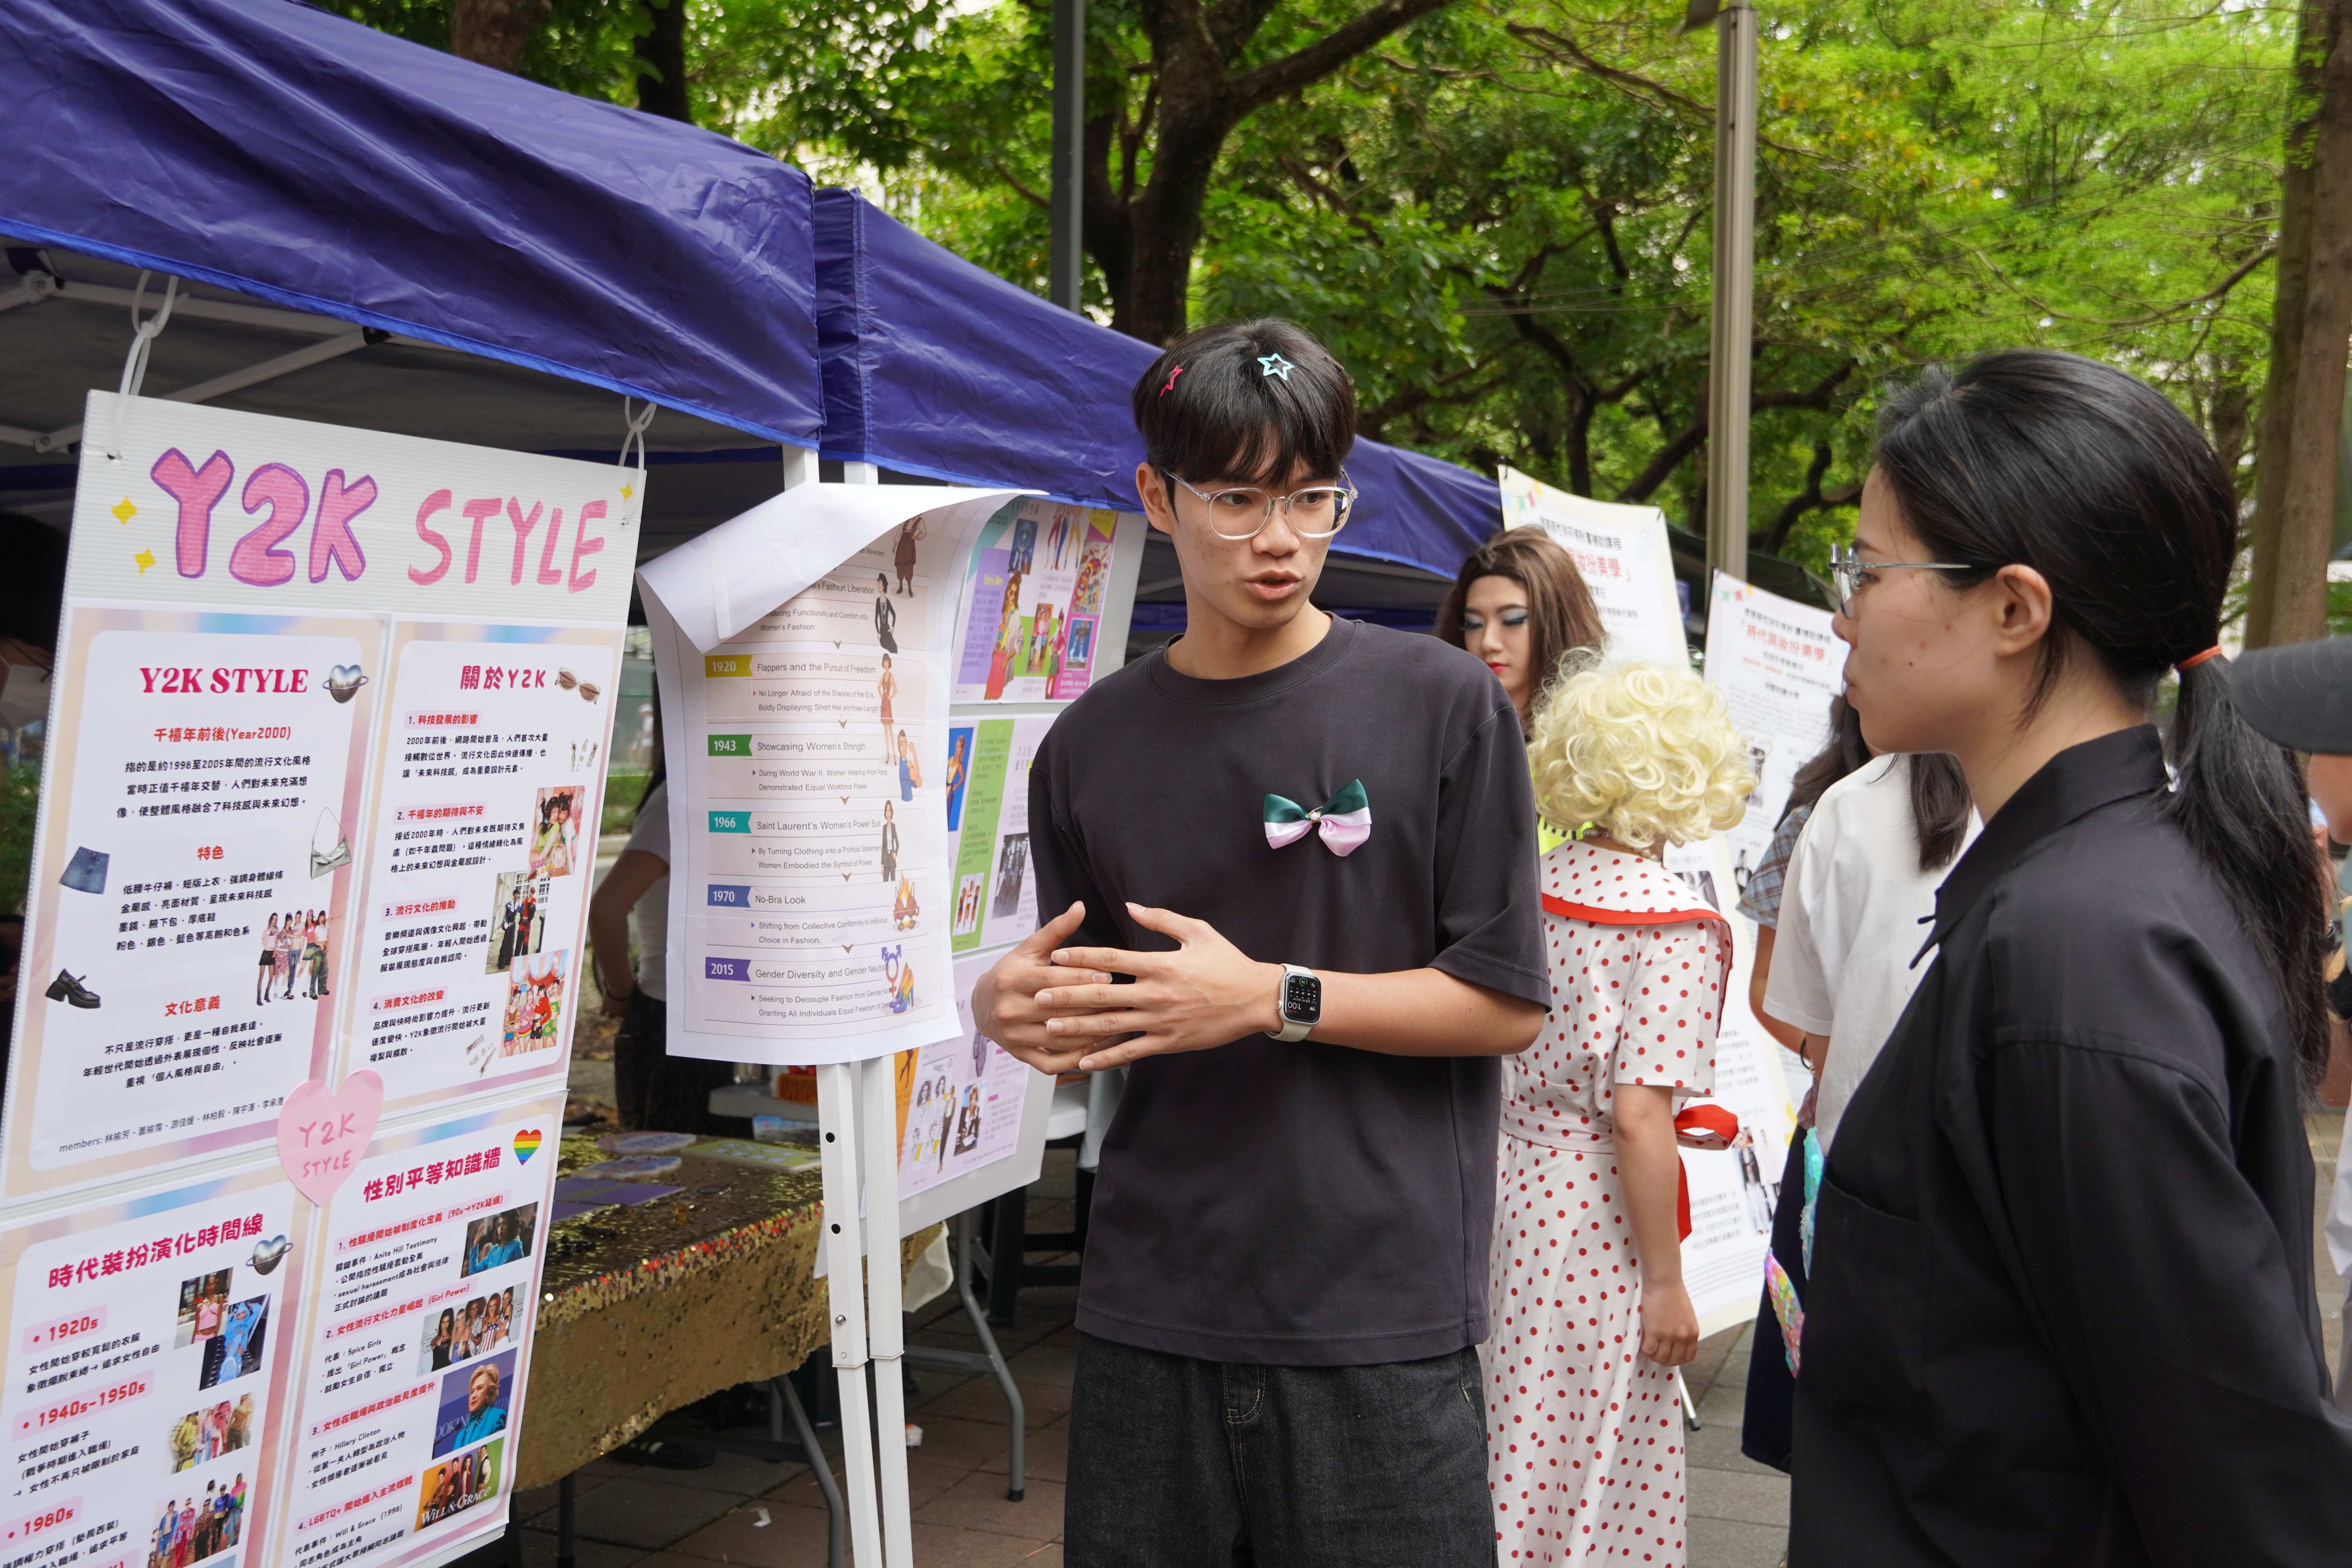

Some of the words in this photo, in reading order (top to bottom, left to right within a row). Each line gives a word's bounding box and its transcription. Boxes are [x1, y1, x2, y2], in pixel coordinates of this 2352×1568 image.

[150, 446, 378, 587] Y2K
[408, 489, 608, 593] STYLE
[866, 548, 885, 557] Movement
[822, 582, 846, 592] Fashion
[848, 584, 875, 595] Liberation
[793, 609, 828, 619] Functionality
[838, 611, 858, 620] Comfort
[759, 622, 786, 632] Women's
[712, 661, 737, 672] 1920
[757, 663, 788, 673] Flappers
[789, 662, 806, 671] and
[809, 663, 822, 671] the
[824, 663, 843, 672] Pursuit
[844, 664, 849, 673] of
[850, 664, 876, 673] Freedom
[140, 668, 203, 693] Y2K
[210, 668, 309, 694] STYLE
[460, 665, 546, 690] 關於Y2K
[768, 690, 789, 699] Longer
[758, 704, 776, 713] Boldly
[777, 704, 812, 712] Displaying
[851, 705, 878, 713] Knee-Length
[417, 714, 478, 725] 科技發展的影響
[153, 726, 291, 742] 千禧年前後(Year2000)
[407, 733, 548, 745] 2000年前後，網路開始普及，人們首次大量
[713, 740, 737, 751] 1943
[757, 742, 804, 753] Showcasing
[806, 742, 842, 751] Women's
[843, 742, 866, 752] Strength
[125, 755, 311, 773] 指的是約1998至2005年間的流行文化風格
[759, 769, 778, 779] During
[847, 769, 866, 777] Wearing
[805, 784, 826, 792] Equal
[408, 805, 484, 820] 千禧年的期待與不安
[713, 817, 736, 828] 1966
[757, 821, 775, 830] Saint
[777, 822, 818, 830] Laurent's
[820, 821, 852, 830] Women's
[853, 820, 870, 828] Power
[871, 819, 881, 828] Suit
[197, 845, 224, 861] 特色
[758, 847, 766, 856] By
[767, 847, 792, 857] Turning
[794, 848, 824, 856] Clothing
[390, 856, 491, 873] 格上的未來幻想與金屬感設計。
[833, 860, 853, 869] Symbol
[713, 891, 735, 902] 1970
[755, 895, 782, 904] No-Bra
[784, 896, 806, 904] Look
[395, 899, 456, 916] 流行文化的推動
[118, 912, 216, 933] 墨鏡、腋下包、厚底鞋
[385, 919, 487, 941] 音樂頻道與偶像文化興起，帶動
[759, 922, 782, 931] Shifting
[837, 920, 864, 928] Conformity
[382, 934, 487, 957] 全球穿搭風潮。年輕人開始透過
[759, 936, 781, 944] Choice
[380, 952, 467, 973] 服裝展現態度與自我認同。
[711, 964, 734, 975] 2015
[755, 969, 785, 979] Gender
[787, 970, 826, 980] Diversity
[828, 969, 842, 978] and
[844, 967, 867, 976] Gender
[164, 995, 221, 1017] 文化意義
[384, 990, 444, 1009] 消費文化的改變
[759, 995, 784, 1005] Seeking
[795, 995, 829, 1004] Decouple
[1288, 1001, 1301, 1010] 1:00
[759, 1009, 786, 1019] Granting
[799, 1009, 837, 1017] Individuals
[838, 1007, 854, 1016] Equal
[855, 1005, 876, 1013] Freedom
[299, 1112, 355, 1149] Y2K
[59, 1138, 103, 1152] members:
[303, 1149, 353, 1178] STYLE
[363, 1147, 501, 1203] 性別平等知識牆
[348, 1212, 443, 1248] 性騷擾開始被制度化定義
[48, 1213, 263, 1289] 時代裝扮演化時間線
[393, 1245, 404, 1254] Hill
[406, 1237, 438, 1250] Testimony
[338, 1285, 360, 1298] sexual
[334, 1288, 388, 1312] 正式討論的議題
[337, 1298, 424, 1336] 女性流行文化力量崛起
[445, 1283, 470, 1298] Power)
[49, 1316, 98, 1341] 1920s
[367, 1339, 381, 1348] Girls
[102, 1344, 160, 1370] 追求女性自由
[39, 1381, 146, 1427] 1940s-1950s
[323, 1381, 435, 1432] 女性在職場與政治能見度提升
[358, 1428, 381, 1441] Clinton
[18, 1430, 90, 1464] 女性開始穿褲子
[29, 1445, 140, 1494] 女性不再只被限制於家庭
[311, 1451, 387, 1489] 女性領導者逐漸被看見
[309, 1508, 342, 1526] LGBTQ+
[344, 1475, 413, 1512] 開始進入主流媒體
[24, 1507, 74, 1536] 1980s
[358, 1518, 376, 1529] Grace
[381, 1504, 402, 1520] (1998)
